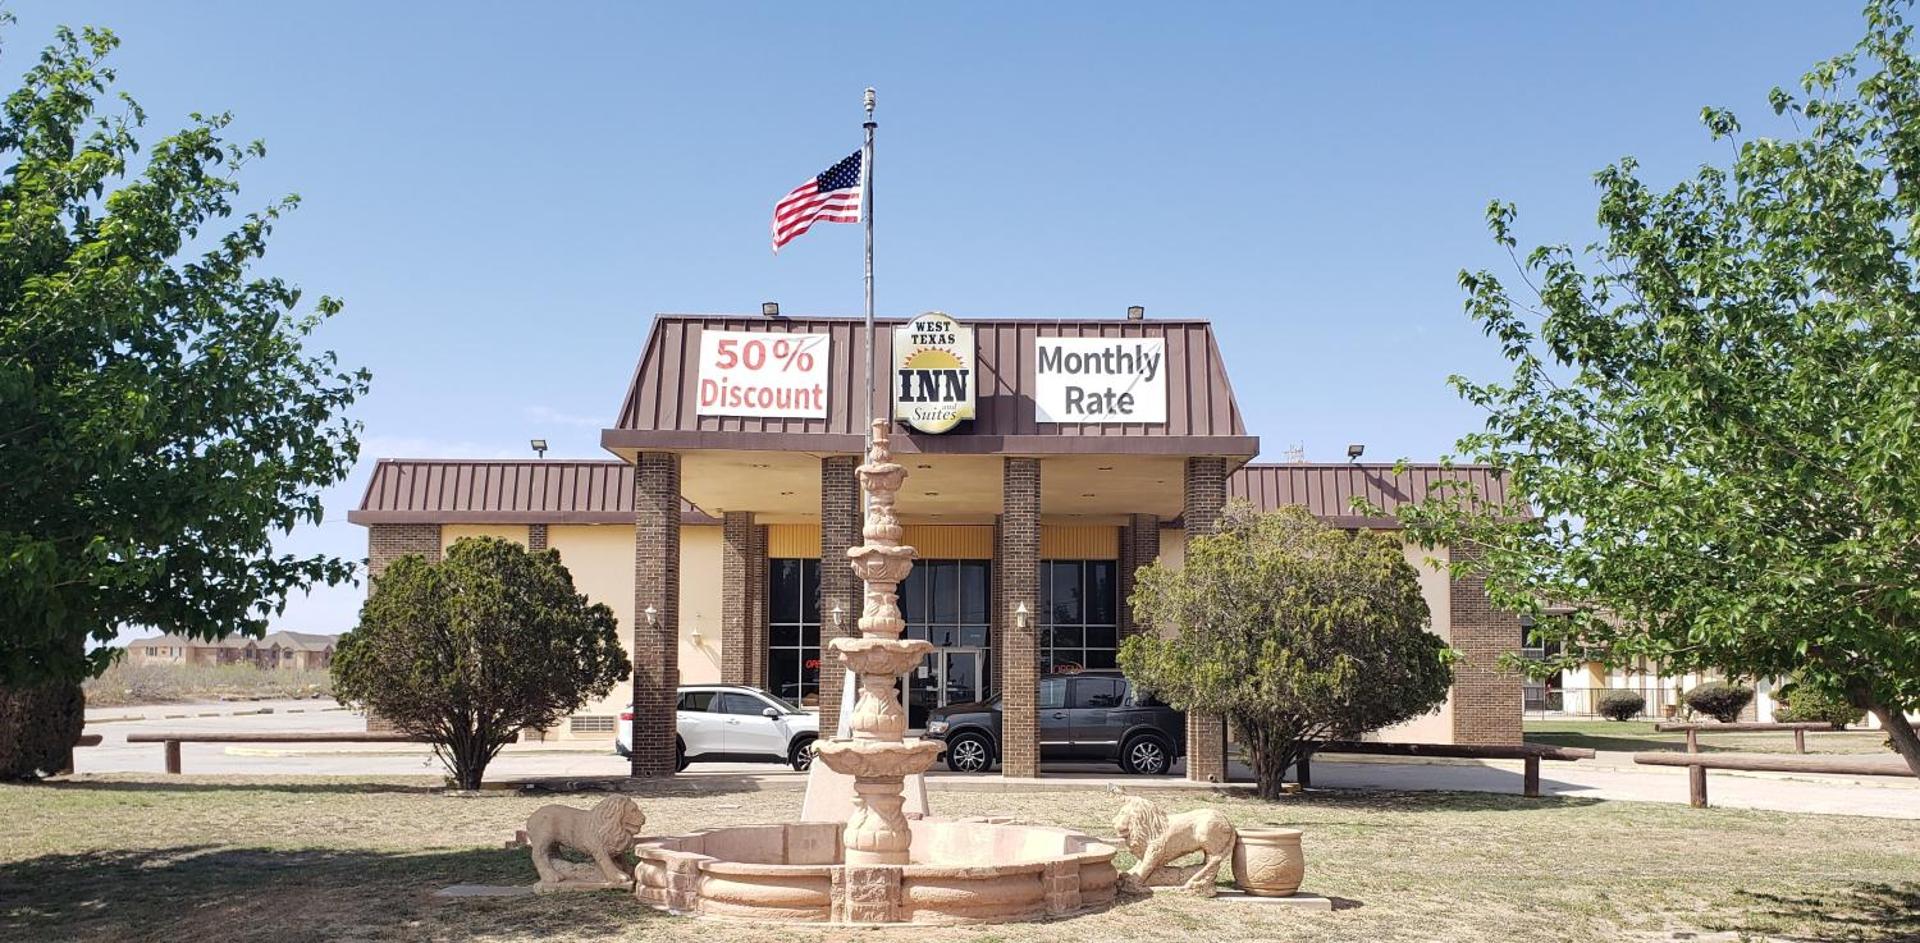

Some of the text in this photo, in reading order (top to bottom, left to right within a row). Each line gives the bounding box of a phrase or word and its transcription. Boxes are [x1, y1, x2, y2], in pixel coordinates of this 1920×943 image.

[911, 333, 956, 345] TEXAS
[916, 321, 951, 332] WEST
[715, 339, 814, 372] 50%
[1038, 344, 1161, 382] Monthly
[701, 376, 823, 410] Discount
[898, 369, 970, 402] INN
[1065, 386, 1135, 415] Rate
[912, 407, 957, 420] Suites
